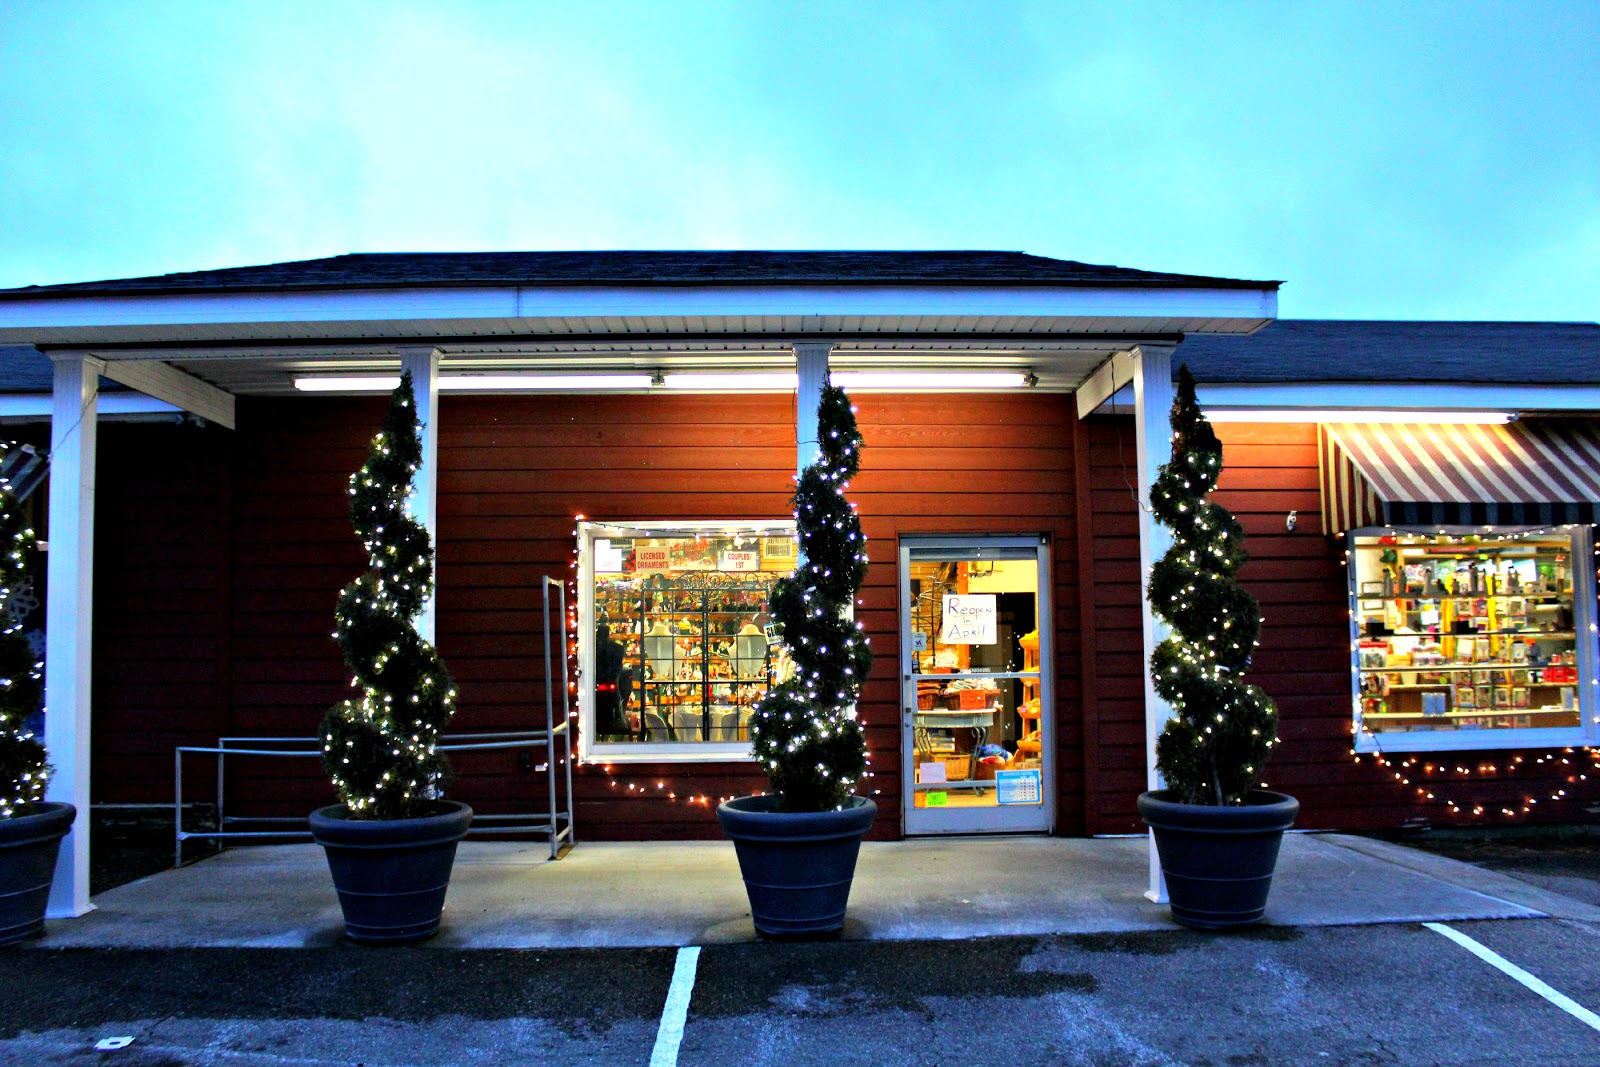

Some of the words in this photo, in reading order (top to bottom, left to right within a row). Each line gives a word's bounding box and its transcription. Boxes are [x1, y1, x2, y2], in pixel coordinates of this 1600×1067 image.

[640, 552, 665, 560] LICENSED
[637, 561, 669, 569] ORNAMENTS
[735, 561, 745, 569] 1ST
[948, 624, 985, 640] April
